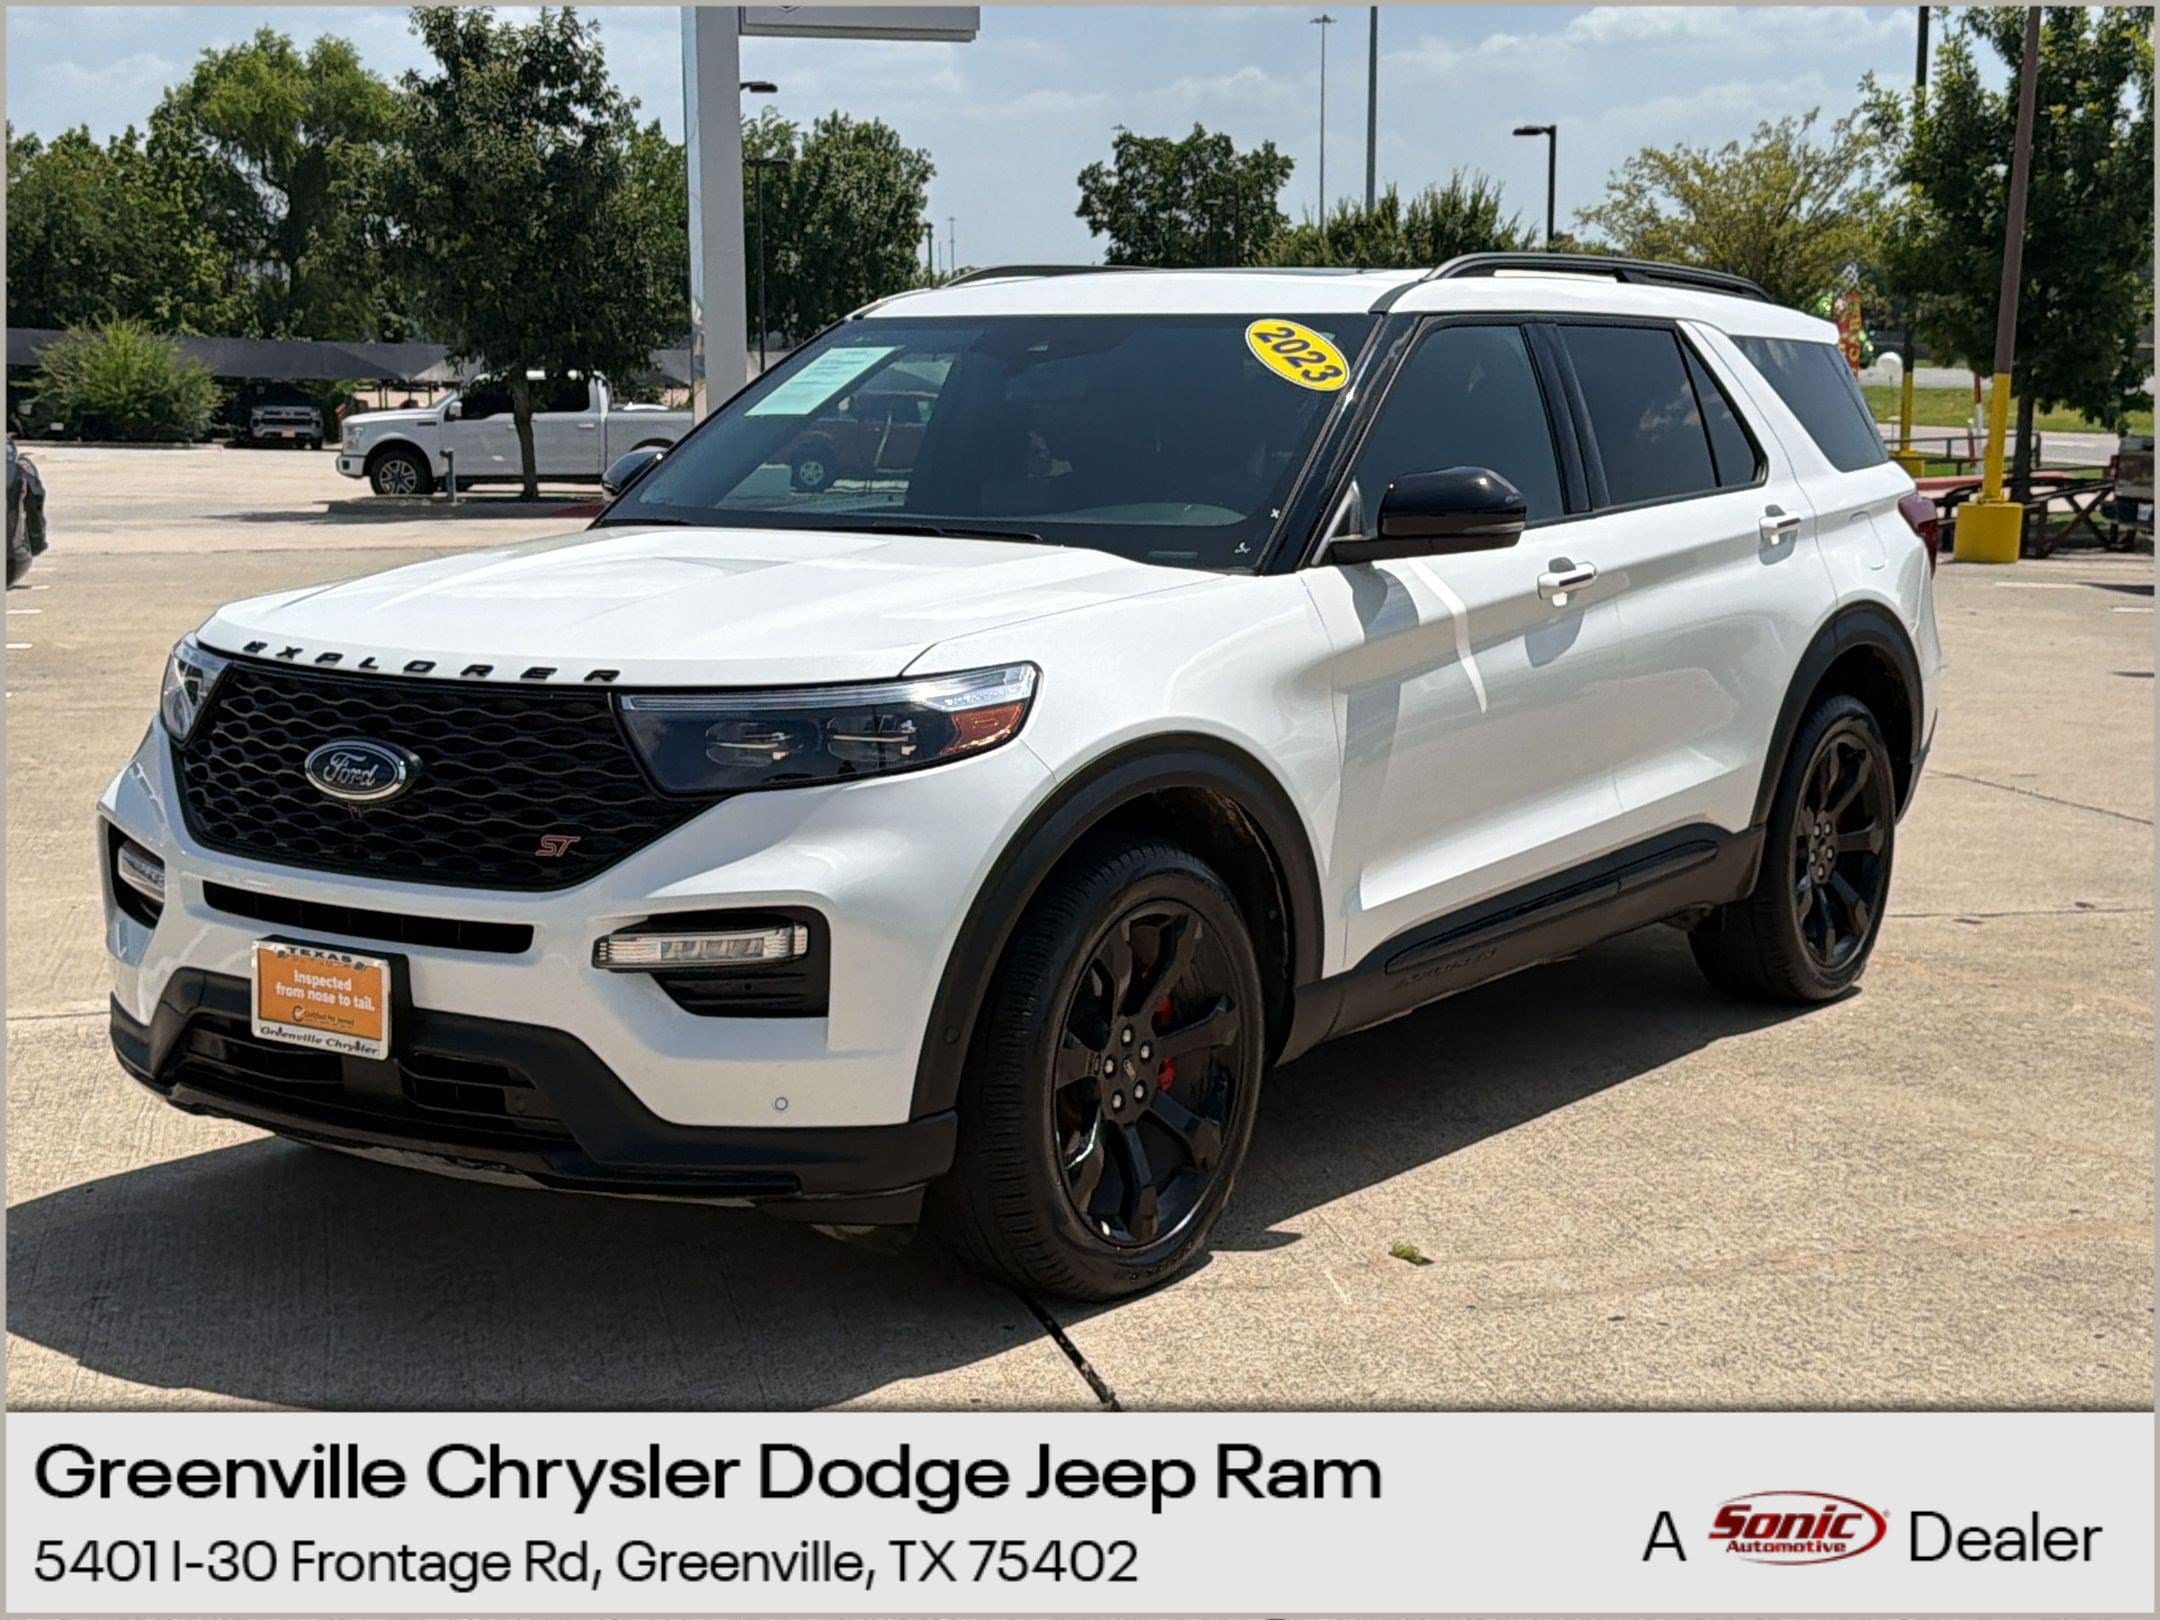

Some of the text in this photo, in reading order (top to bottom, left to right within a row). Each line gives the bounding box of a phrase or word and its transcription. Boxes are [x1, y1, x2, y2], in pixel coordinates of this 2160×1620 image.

[1252, 327, 1343, 382] 2023
[243, 641, 620, 682] EXPLORER
[322, 751, 381, 788] Ford
[535, 834, 581, 857] ST
[287, 947, 352, 963] TEXAS
[293, 969, 352, 993] Inspected
[275, 981, 376, 1012] from nose to tail.
[260, 1026, 323, 1044] Greenville
